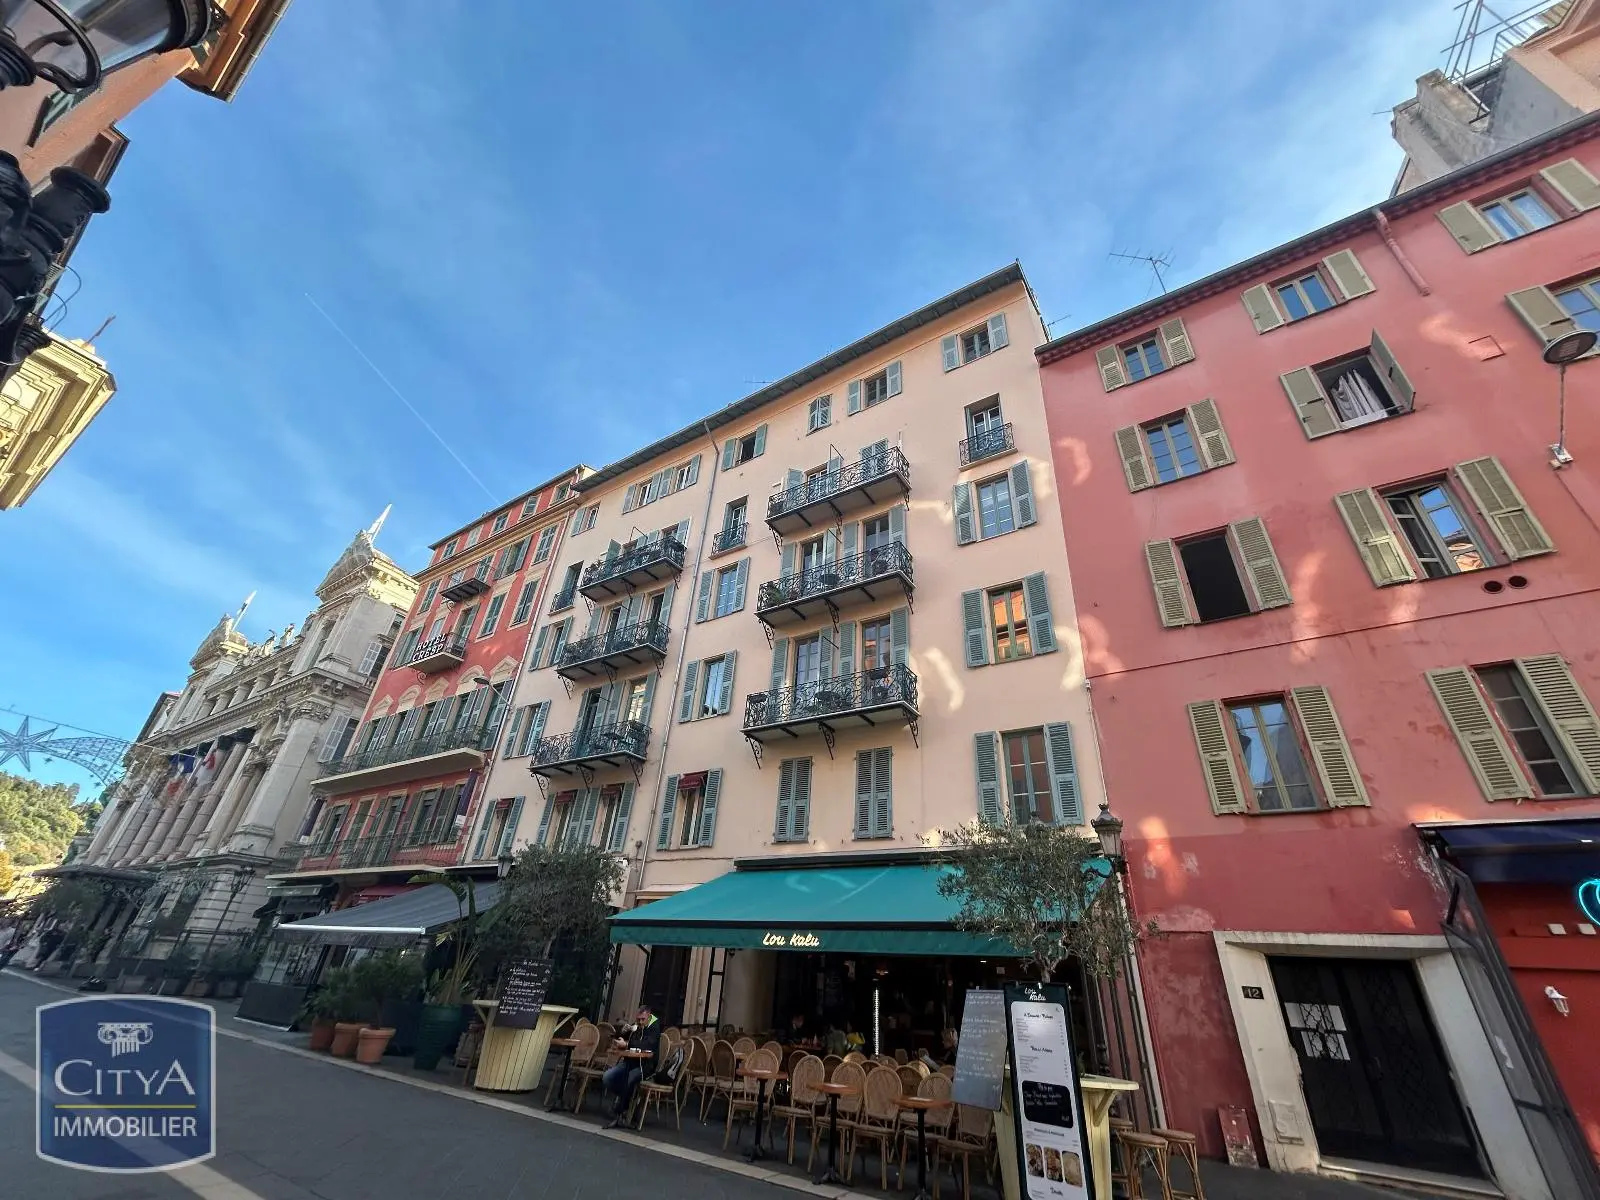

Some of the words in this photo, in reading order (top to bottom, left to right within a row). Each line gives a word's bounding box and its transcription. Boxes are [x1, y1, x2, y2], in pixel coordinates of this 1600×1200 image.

[416, 633, 446, 652] HOTEL
[762, 932, 786, 946] Lou
[789, 932, 820, 947] Kalu
[1024, 987, 1037, 995] Lou
[1246, 988, 1261, 999] 12
